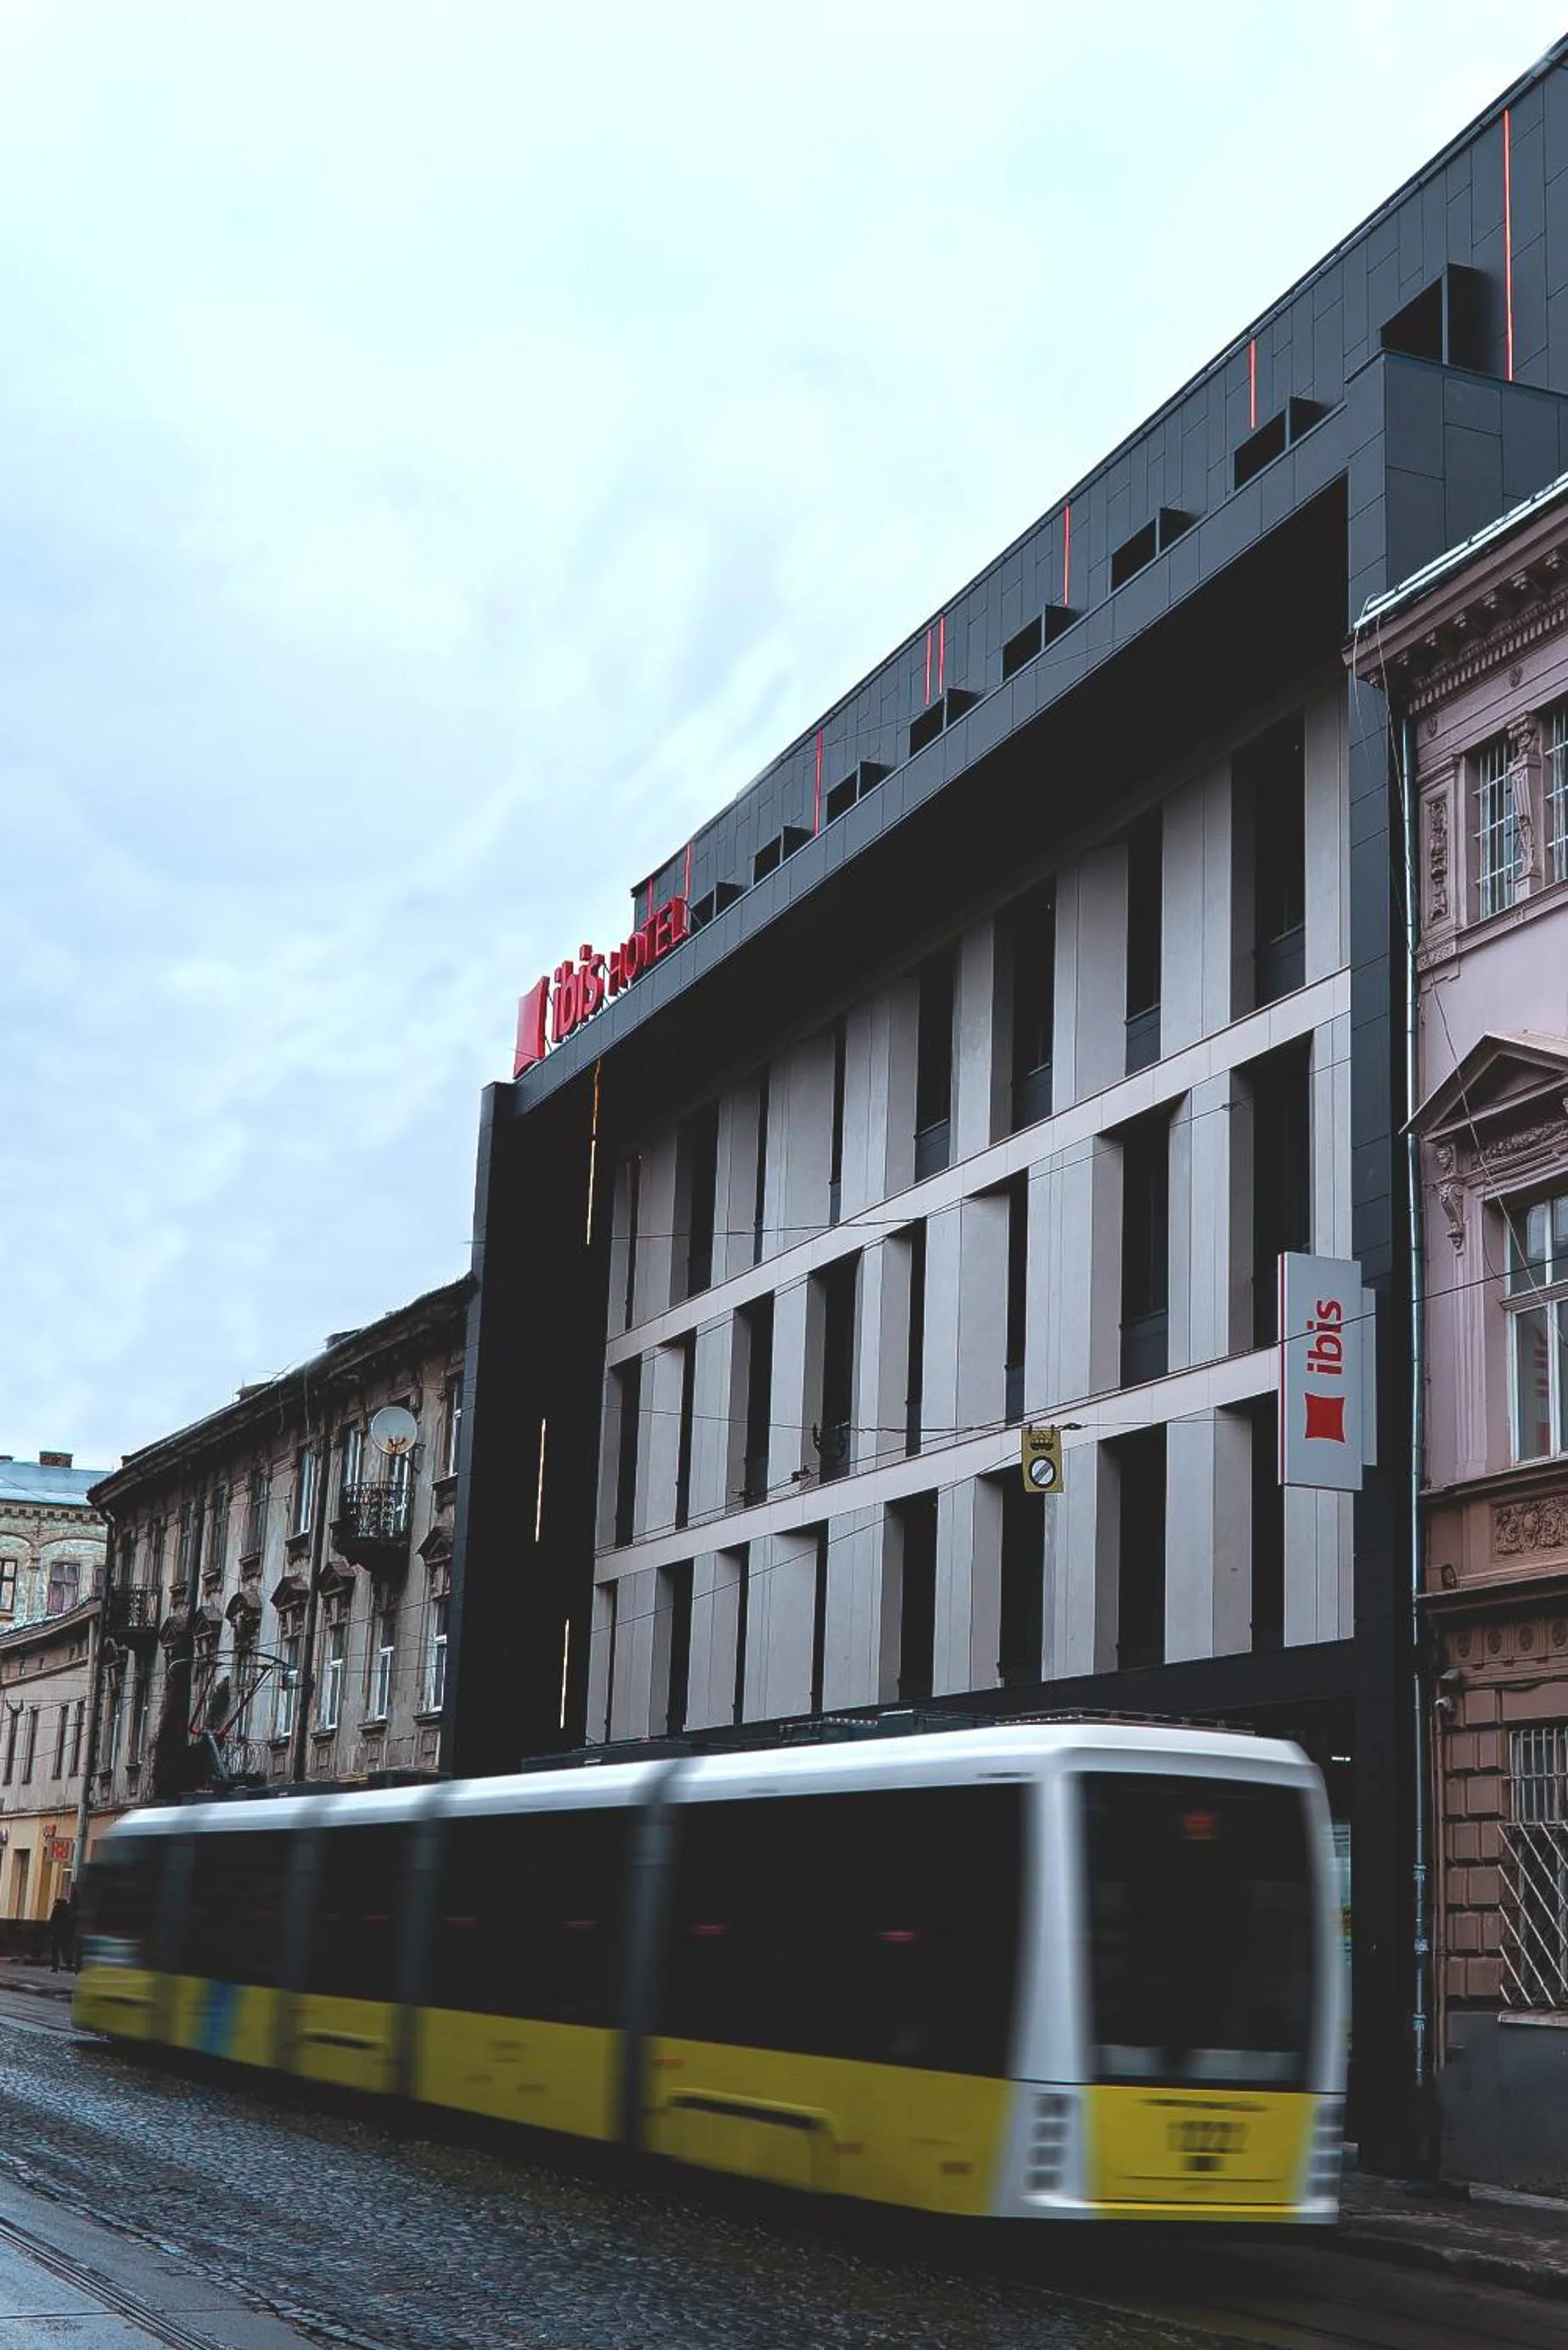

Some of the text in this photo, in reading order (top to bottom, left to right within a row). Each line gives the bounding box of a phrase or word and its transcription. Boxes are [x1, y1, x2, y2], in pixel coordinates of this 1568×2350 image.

[552, 896, 690, 1043] ibis HOTEL
[1307, 1300, 1342, 1375] ibis
